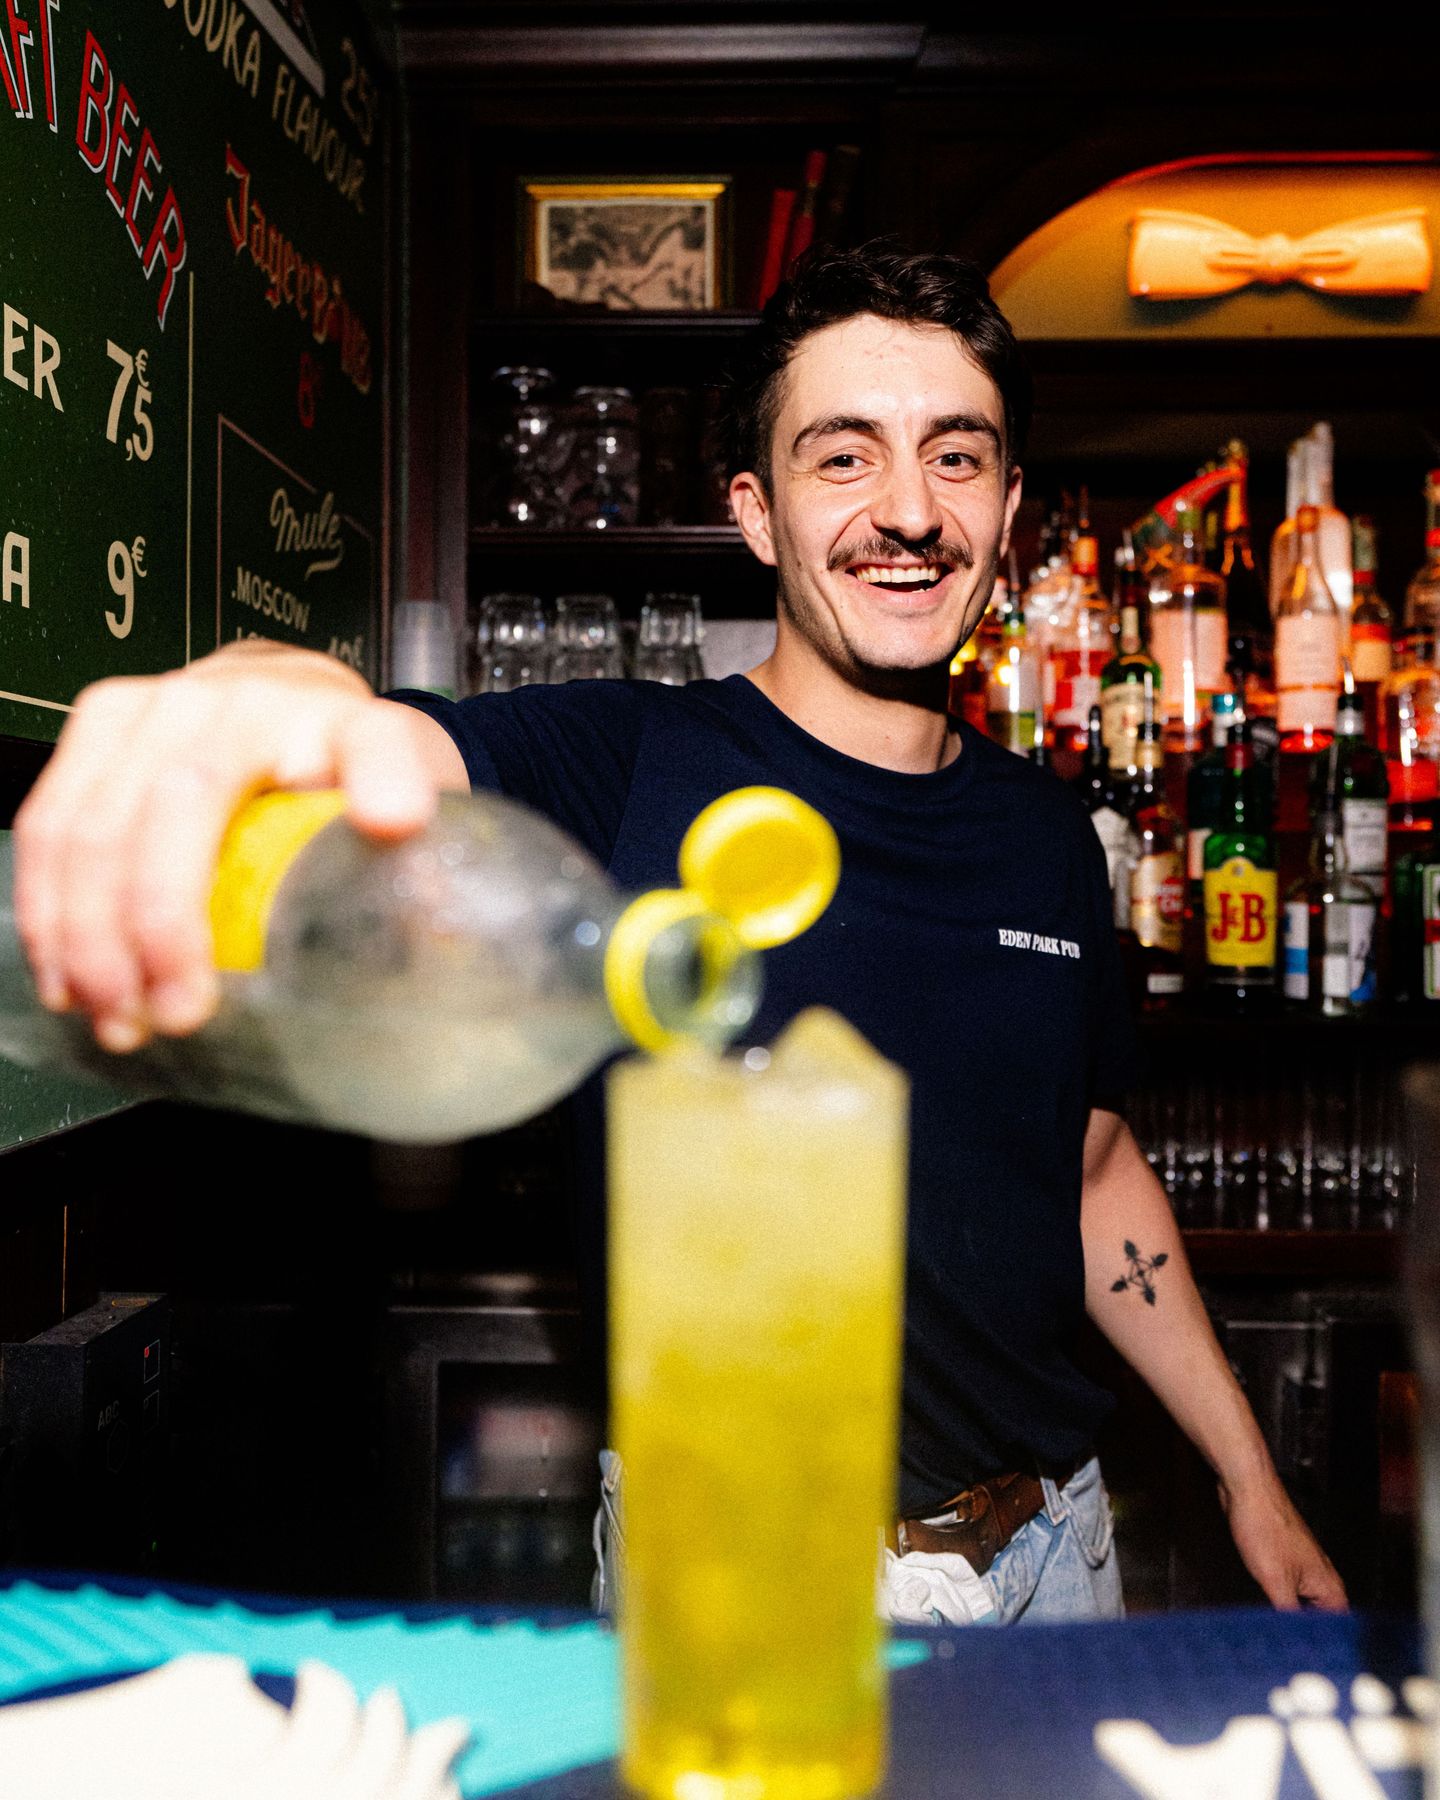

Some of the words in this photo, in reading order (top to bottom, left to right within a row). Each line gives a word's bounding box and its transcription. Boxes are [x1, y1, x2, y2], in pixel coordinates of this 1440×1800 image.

[162, 0, 261, 98] ODKA
[76, 29, 187, 333] BEER
[3, 302, 65, 413] ER
[2, 530, 31, 609] A
[998, 928, 1032, 950] EDEN
[1031, 933, 1060, 955] PARK
[1060, 940, 1081, 959] PUB
